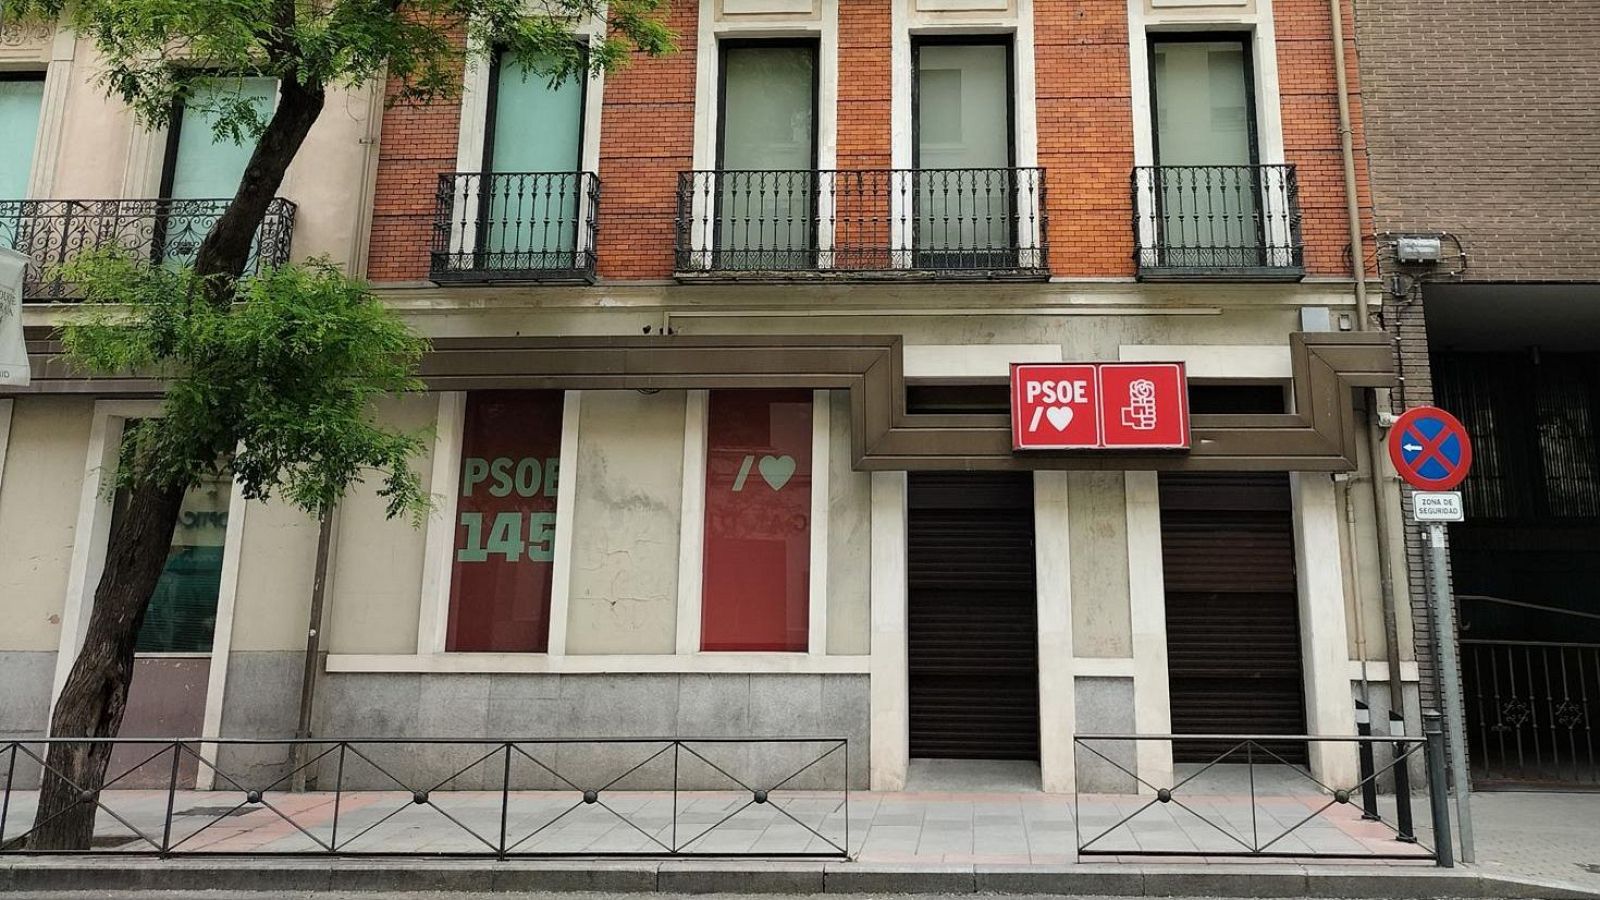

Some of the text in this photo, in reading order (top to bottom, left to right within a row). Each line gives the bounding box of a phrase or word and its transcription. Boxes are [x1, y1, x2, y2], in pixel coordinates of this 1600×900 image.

[1026, 380, 1088, 403] PSOE
[463, 457, 560, 497] PSOE
[457, 512, 557, 562] 145
